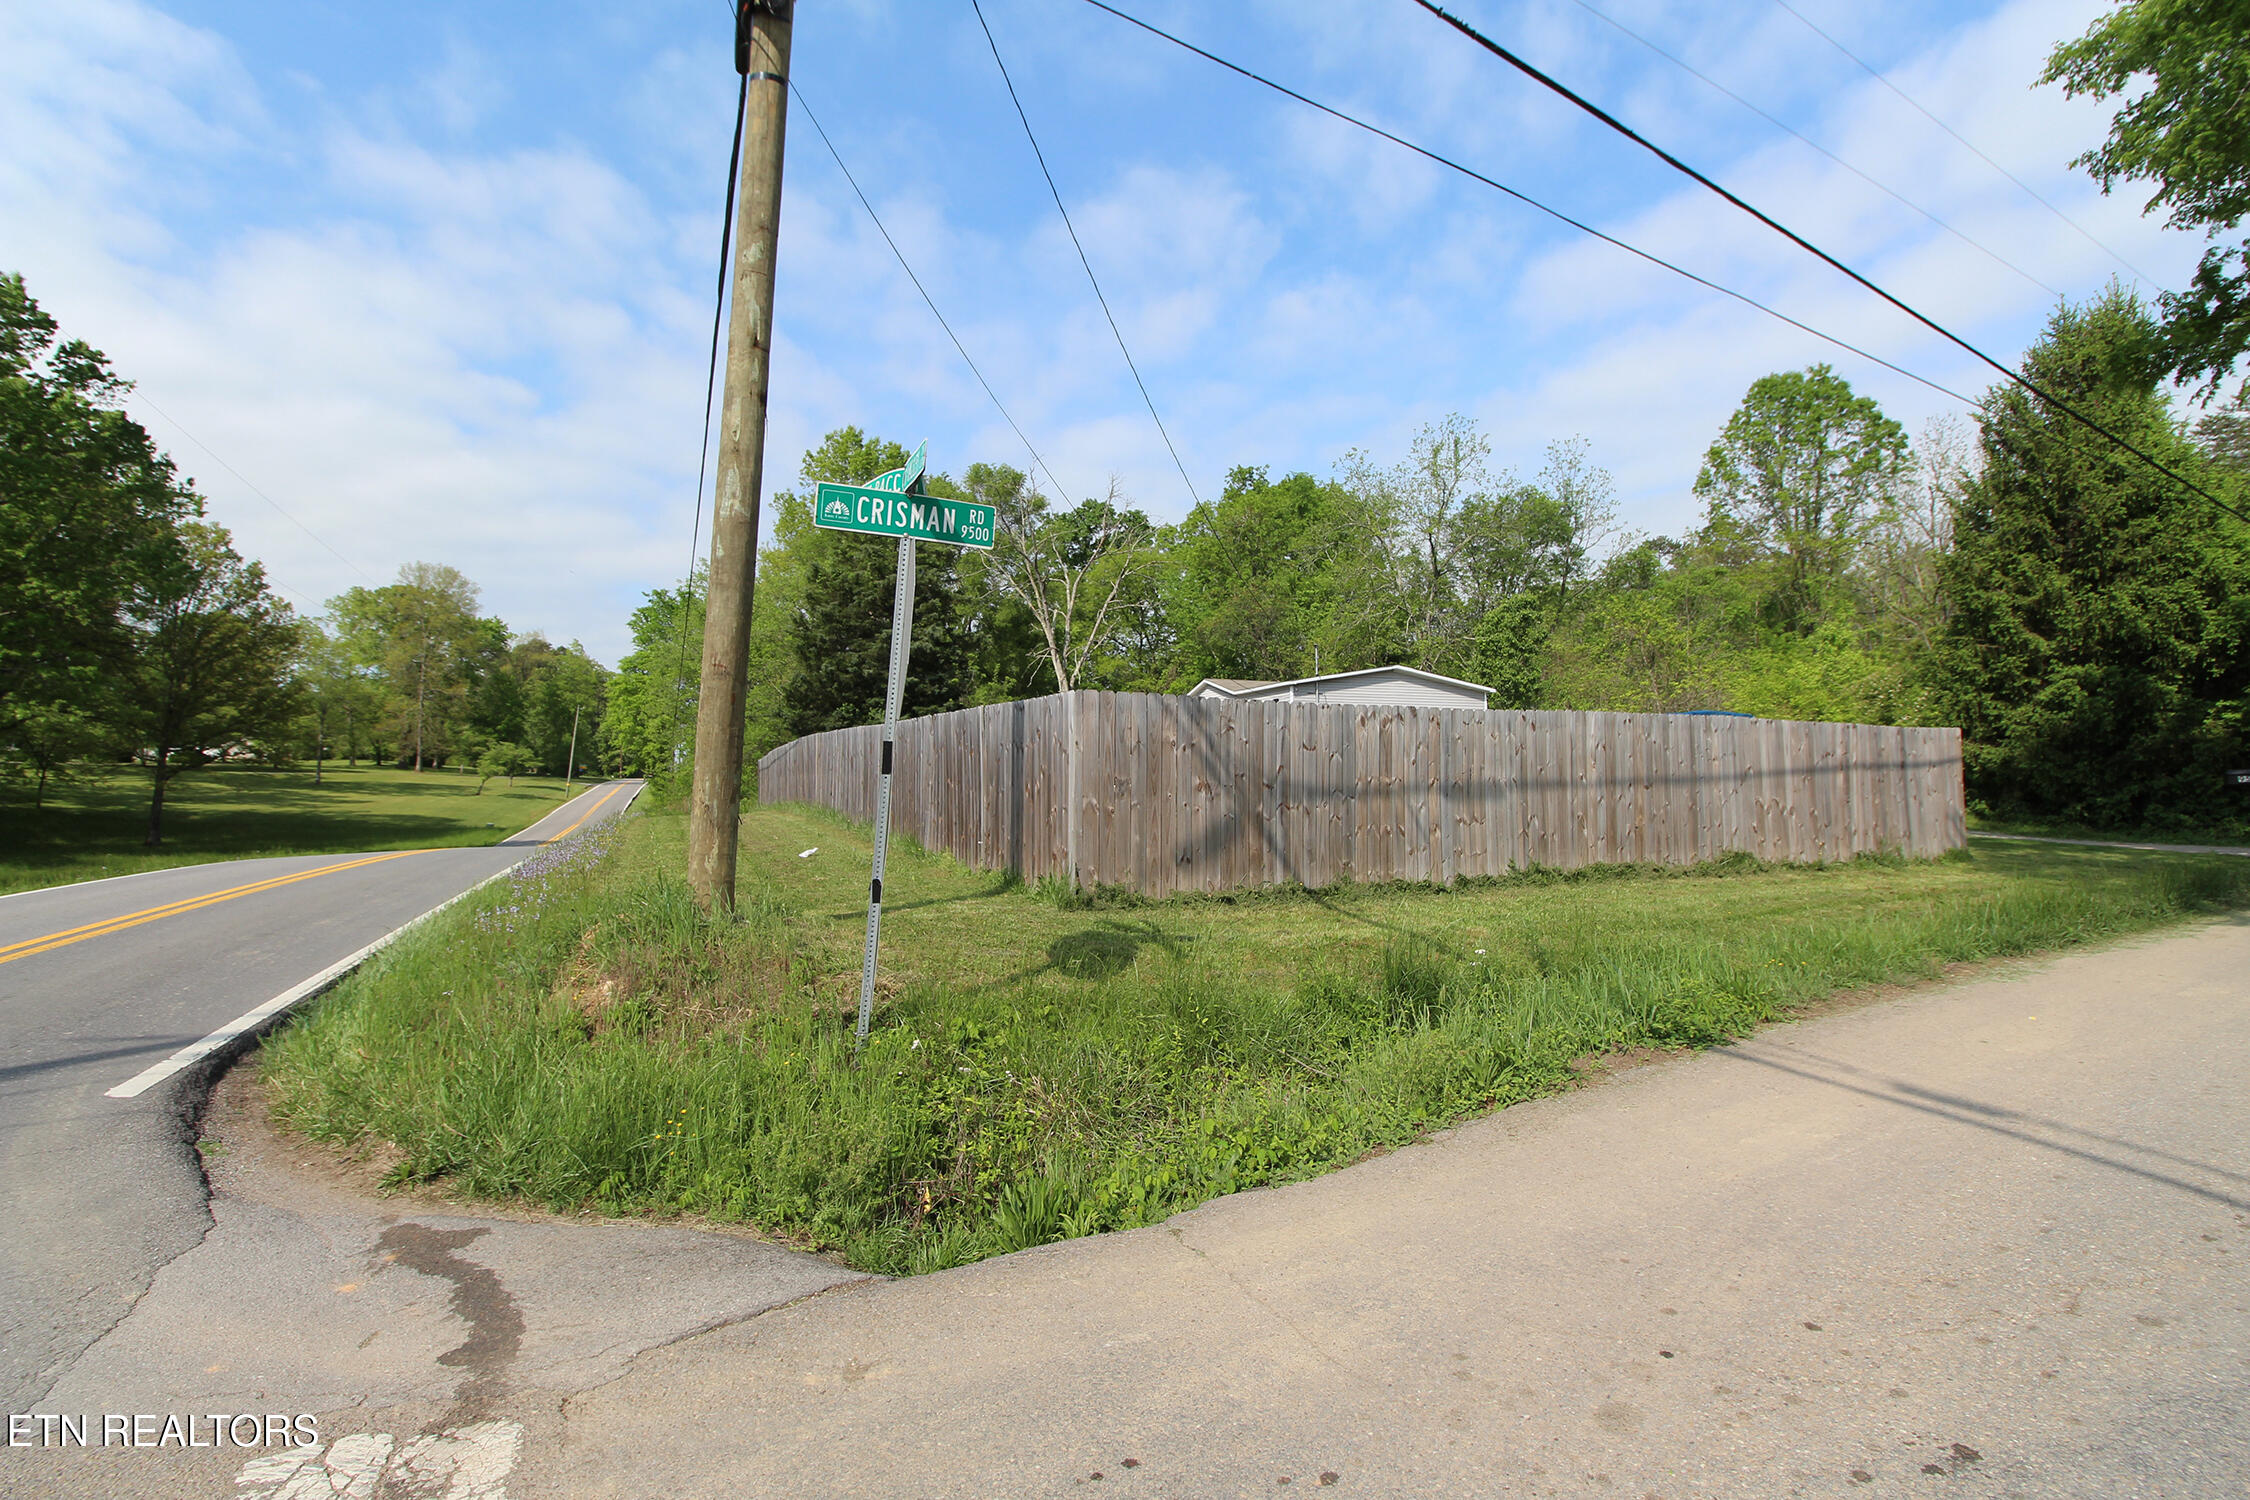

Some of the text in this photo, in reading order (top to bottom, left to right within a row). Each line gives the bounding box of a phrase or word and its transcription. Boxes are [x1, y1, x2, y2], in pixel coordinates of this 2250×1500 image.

[857, 496, 985, 535] CRISMAN RD
[960, 525, 989, 541] 9500
